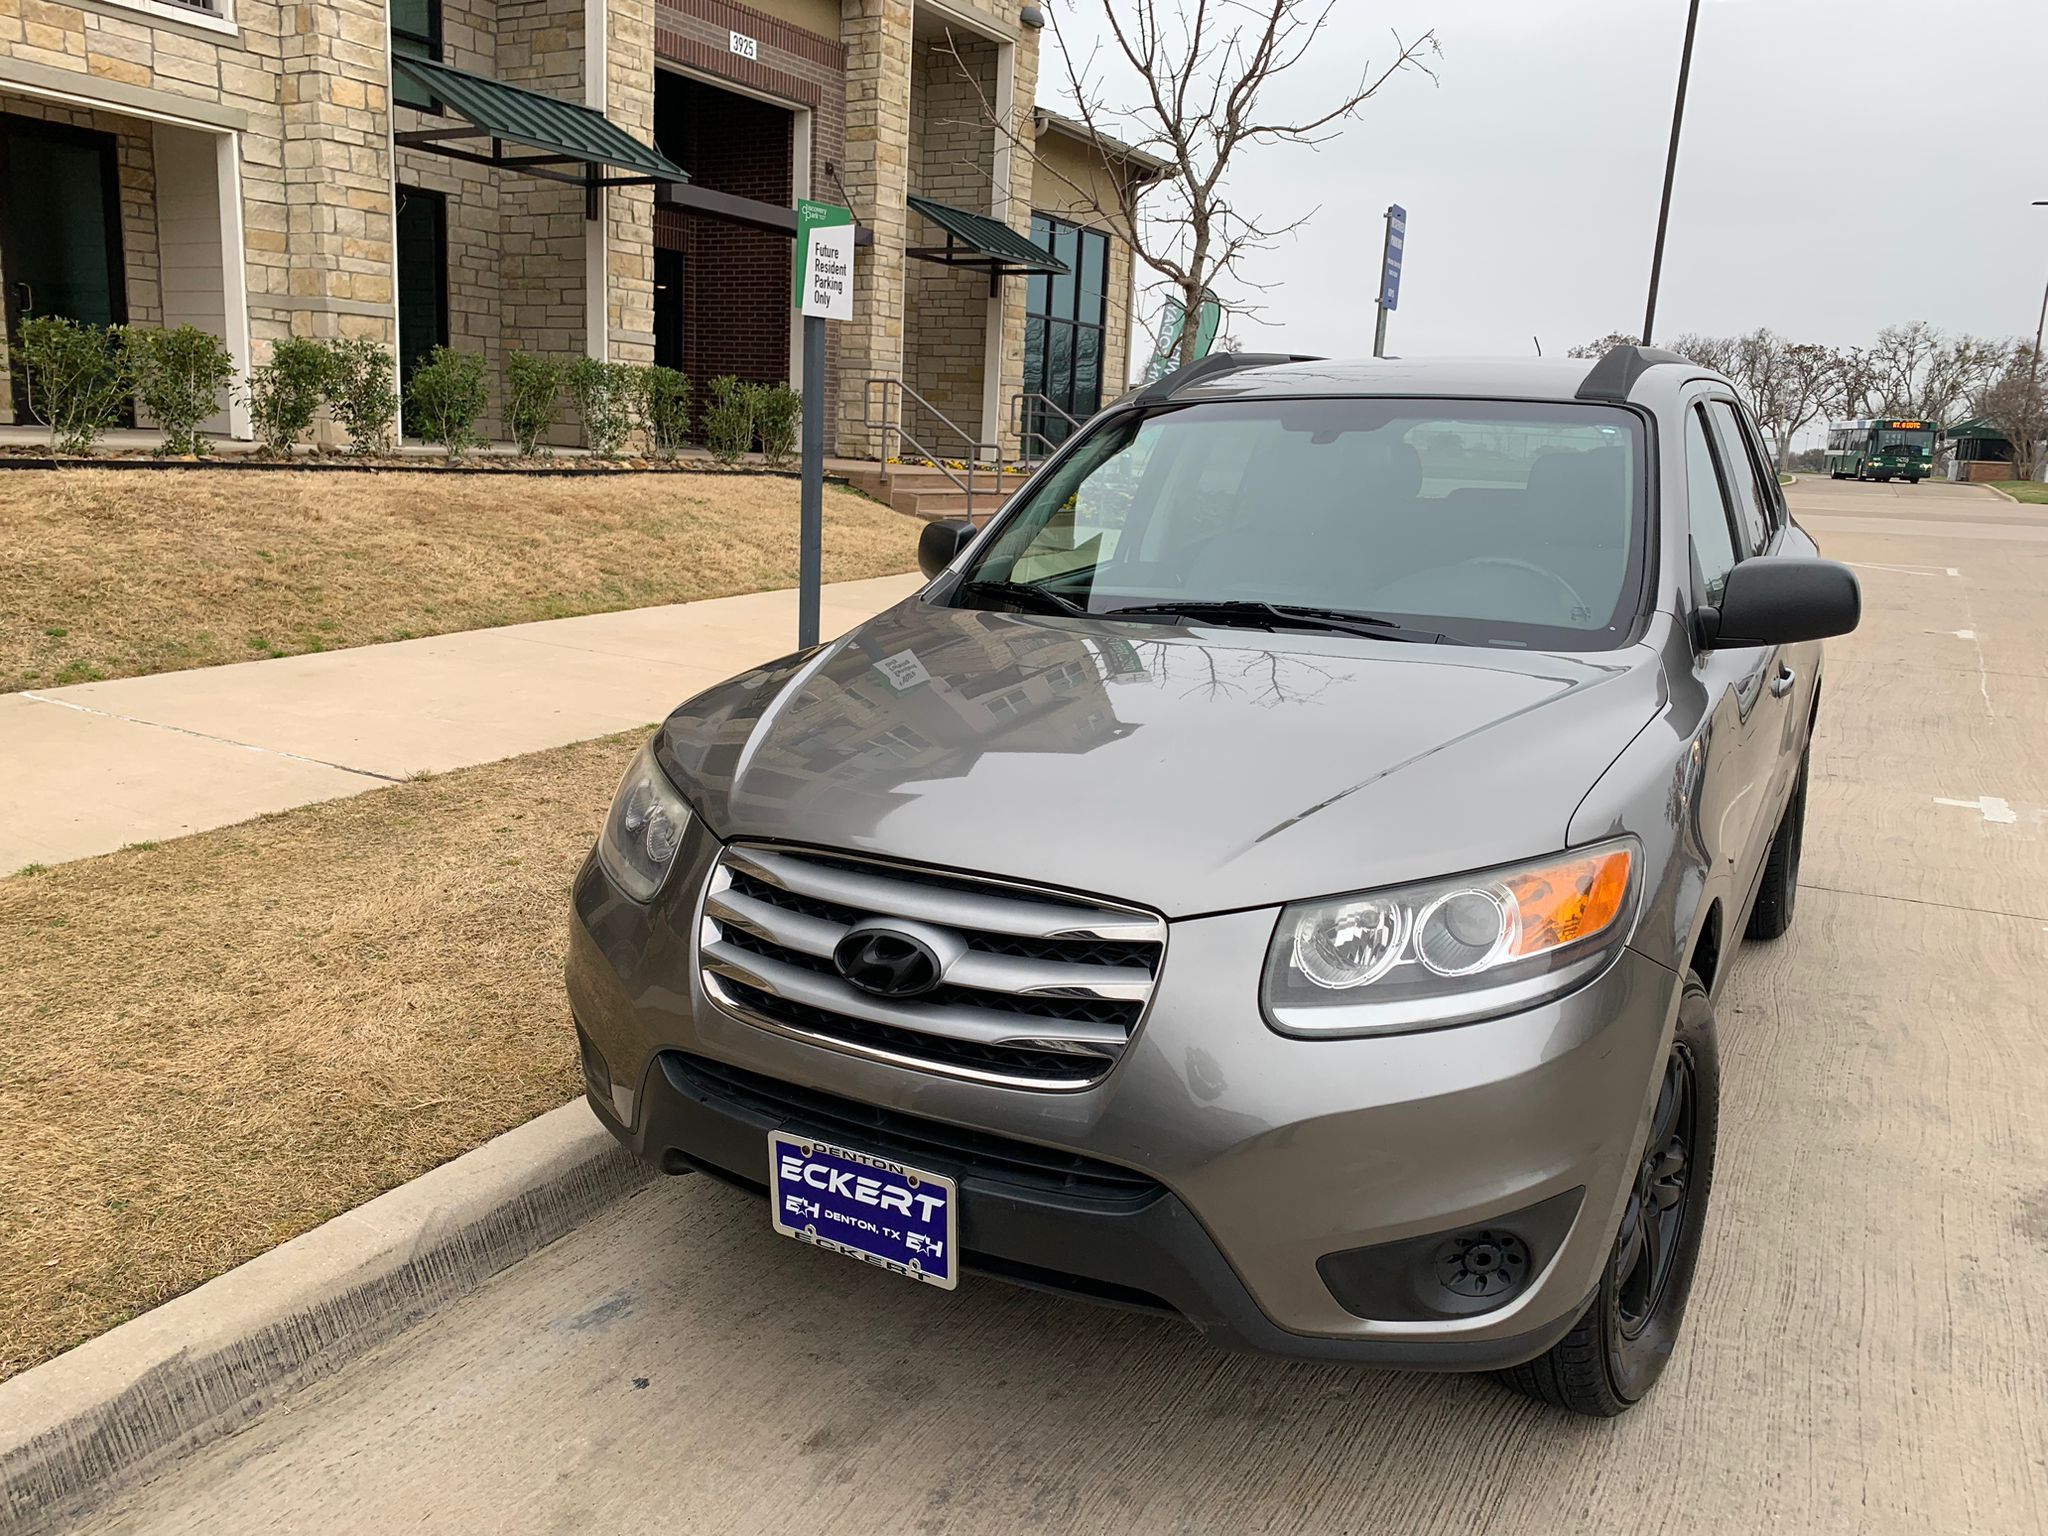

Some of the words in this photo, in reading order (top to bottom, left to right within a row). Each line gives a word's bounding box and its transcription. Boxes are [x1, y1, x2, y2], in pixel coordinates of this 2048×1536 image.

[733, 34, 754, 57] 3925
[815, 242, 839, 259] Future
[815, 258, 847, 276] Resident
[814, 274, 843, 294] Parking
[814, 290, 831, 308] Only
[813, 1143, 905, 1175] DENTON
[780, 1155, 946, 1223] ECKERT
[824, 1210, 879, 1235] DENTON,
[882, 1227, 901, 1241] TX
[794, 1231, 931, 1281] ECKERT
